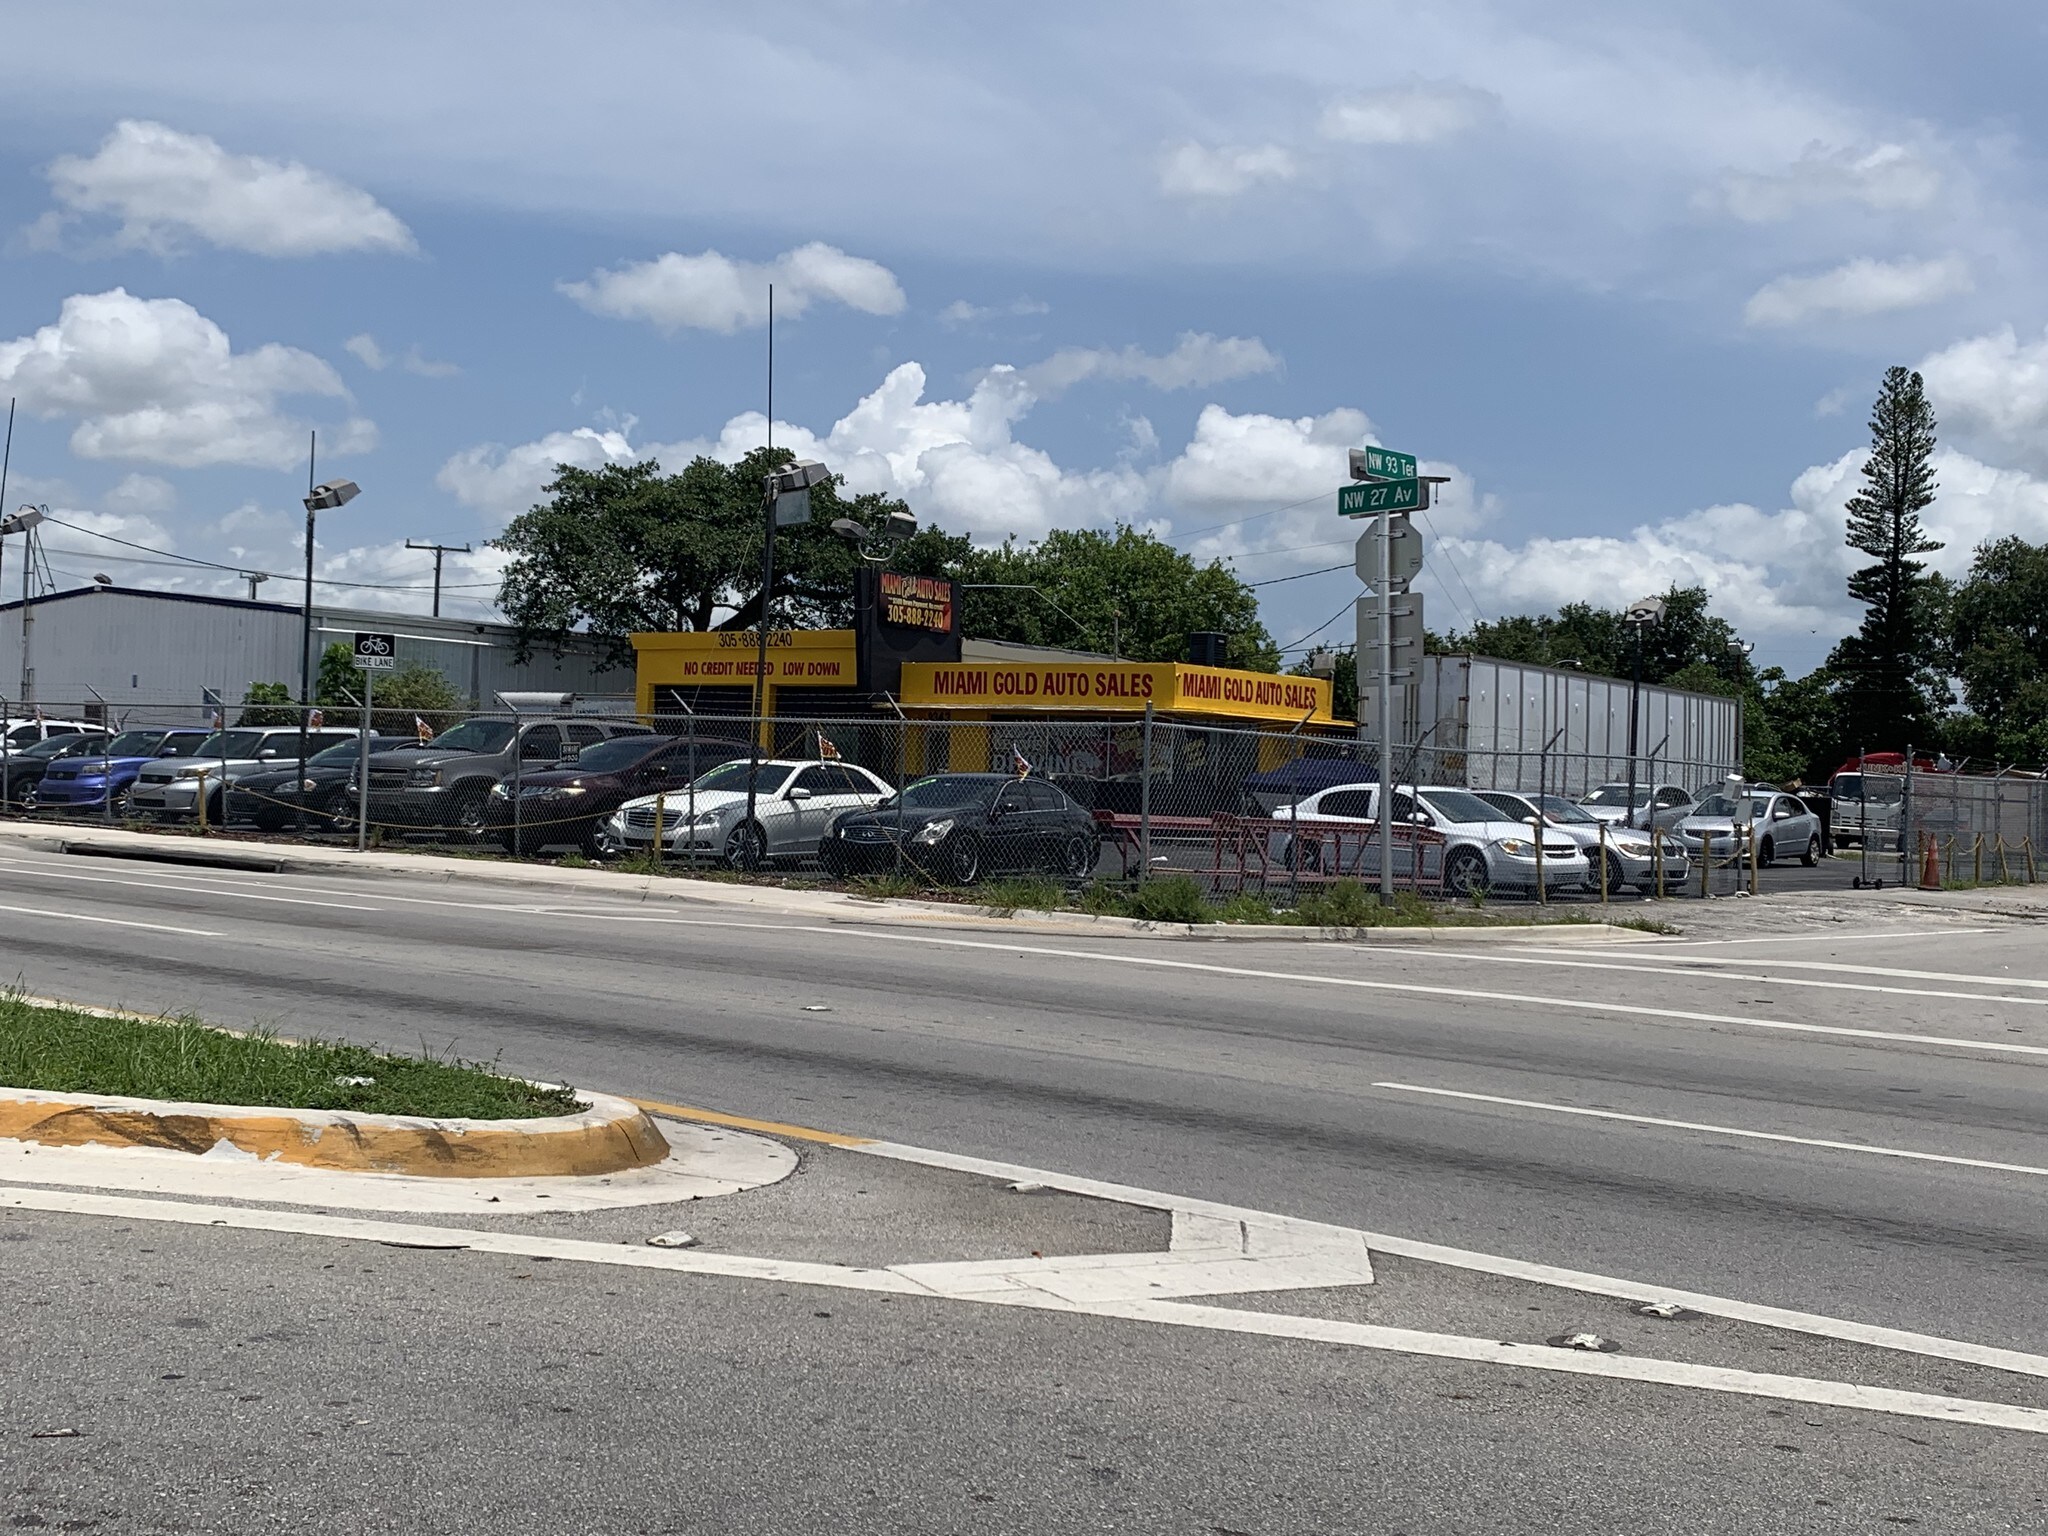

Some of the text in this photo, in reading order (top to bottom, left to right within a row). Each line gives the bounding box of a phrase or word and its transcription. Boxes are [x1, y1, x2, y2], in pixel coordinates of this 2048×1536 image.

[1368, 452, 1415, 476] NW 93 Ter
[1344, 486, 1412, 509] NW 27 Av
[881, 573, 901, 595] MIAMI
[916, 578, 934, 599] AUTO
[934, 581, 951, 602] SALES
[887, 604, 943, 628] 305-888-2240
[355, 657, 393, 667] BIKE LANE
[684, 661, 698, 676] NO
[701, 661, 734, 676] CREDIT
[783, 661, 805, 676] LOW
[808, 661, 840, 676] DOWN
[934, 671, 1154, 698] MIAMI GOLD AUTO SALES
[1183, 672, 1317, 709] MIAMI GOLD AUTO SALES
